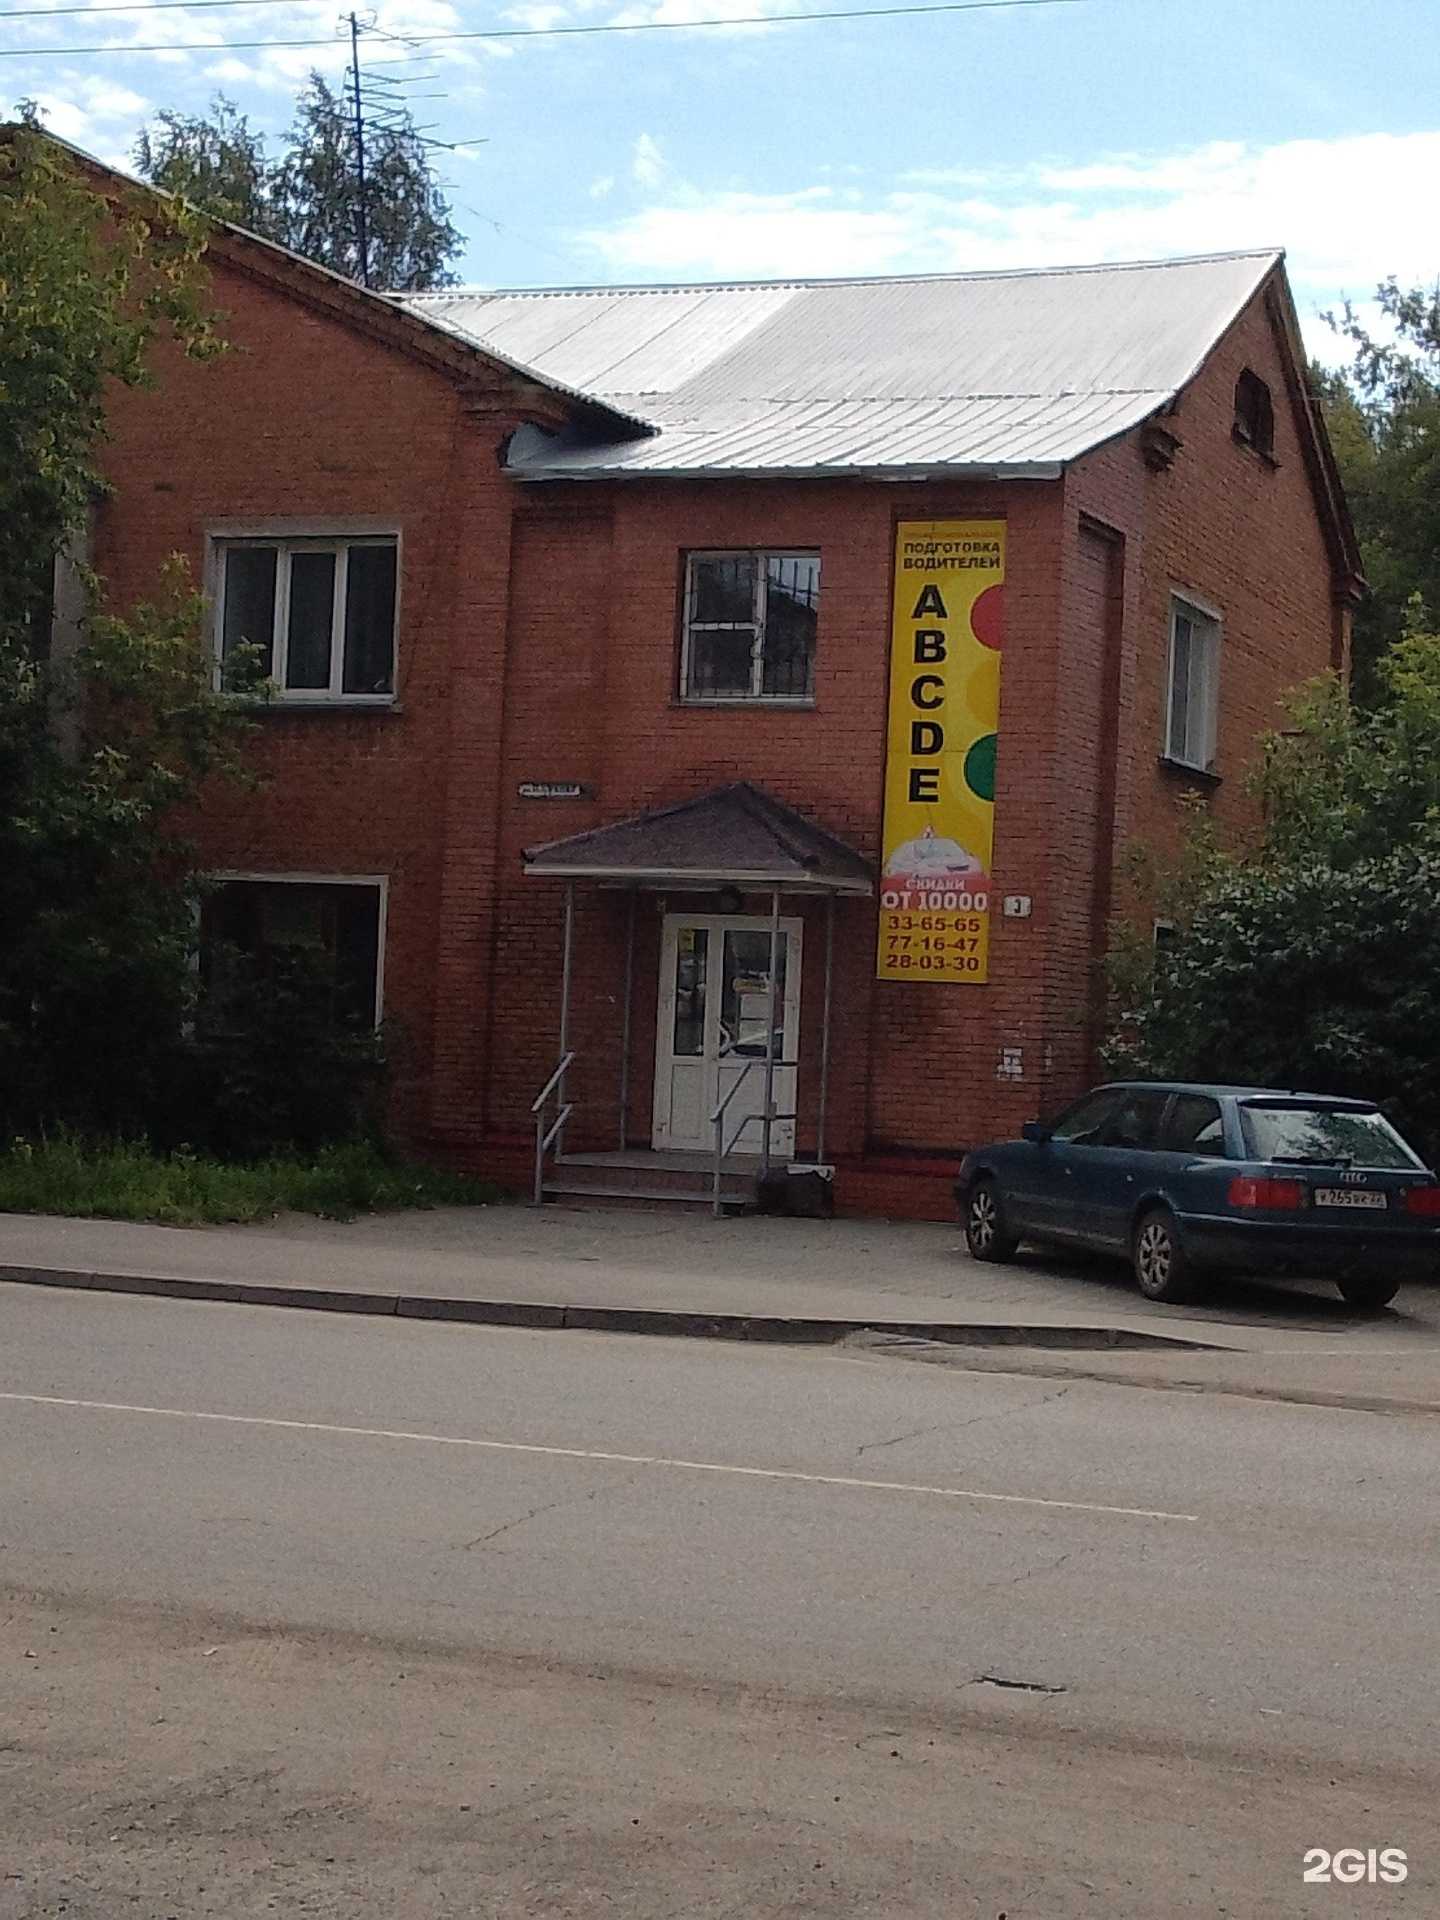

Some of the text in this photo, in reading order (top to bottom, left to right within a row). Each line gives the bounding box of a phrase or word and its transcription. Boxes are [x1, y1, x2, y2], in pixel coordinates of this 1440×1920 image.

[903, 543, 1001, 555] ПОДГОТОВКА
[903, 557, 1001, 570] ВОДИТЕЛЕЙ
[882, 891, 987, 911] ОТ 10000
[888, 916, 980, 932] 33-65-65
[887, 935, 979, 952] 77-16-47
[886, 954, 979, 971] 28-03-30
